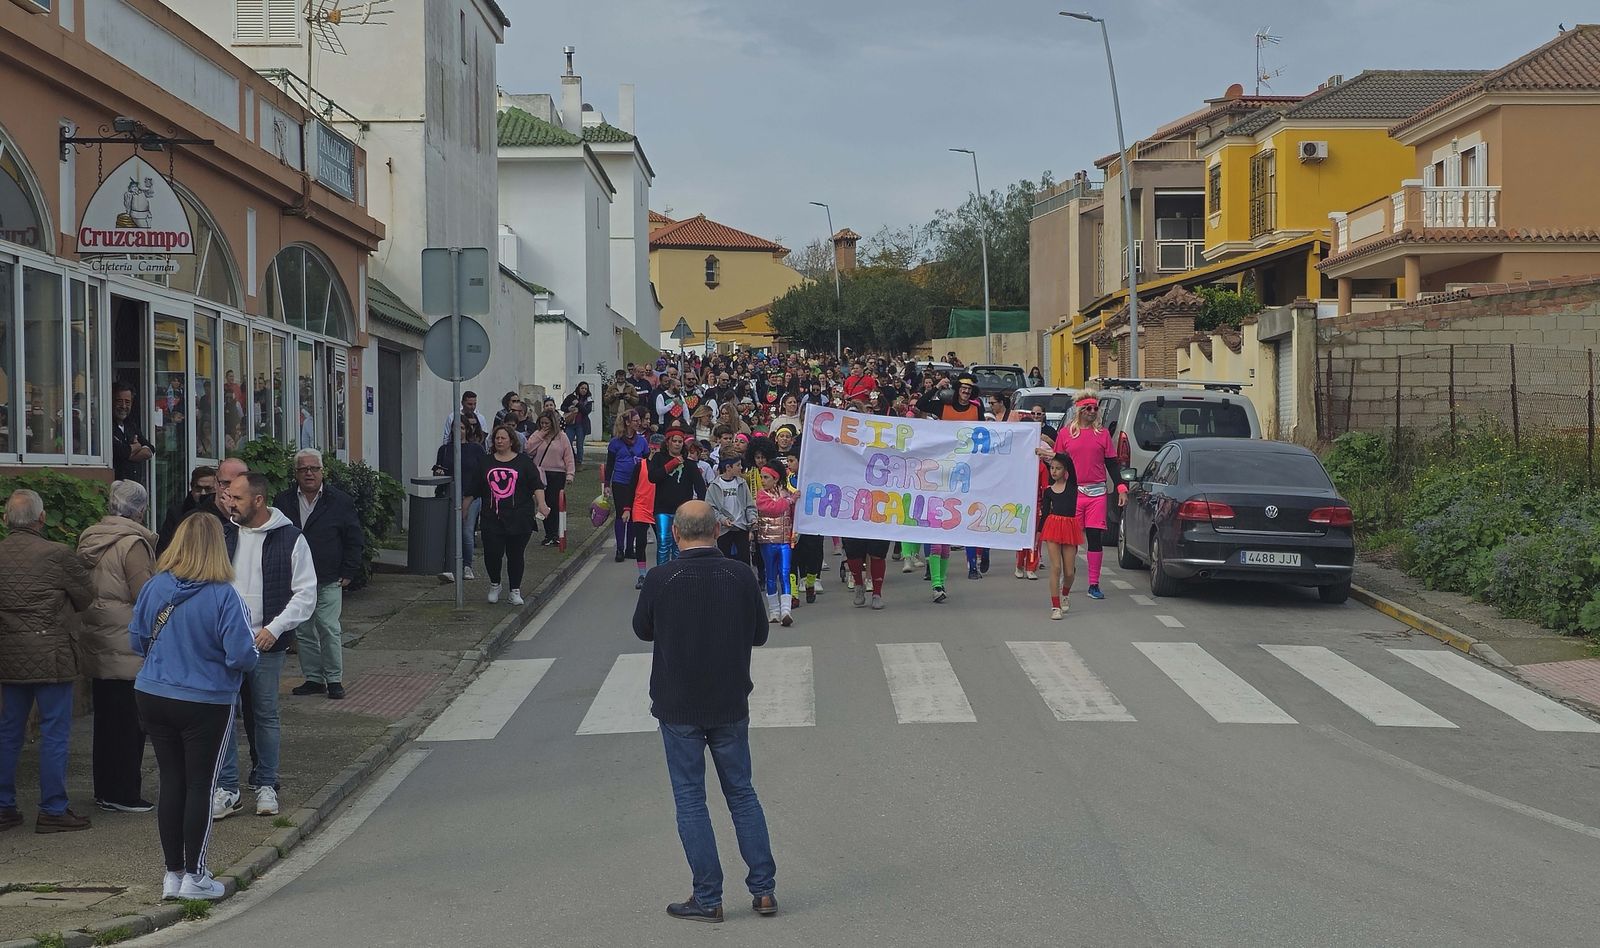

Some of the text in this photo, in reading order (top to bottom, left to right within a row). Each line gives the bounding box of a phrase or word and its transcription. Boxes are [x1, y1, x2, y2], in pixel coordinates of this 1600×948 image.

[80, 227, 190, 251] Cruzcampo
[138, 260, 174, 272] Carmen
[954, 426, 1013, 455] SAN
[804, 482, 1031, 534] PASACALLES 2024
[1248, 552, 1299, 565] 4488 JJV
